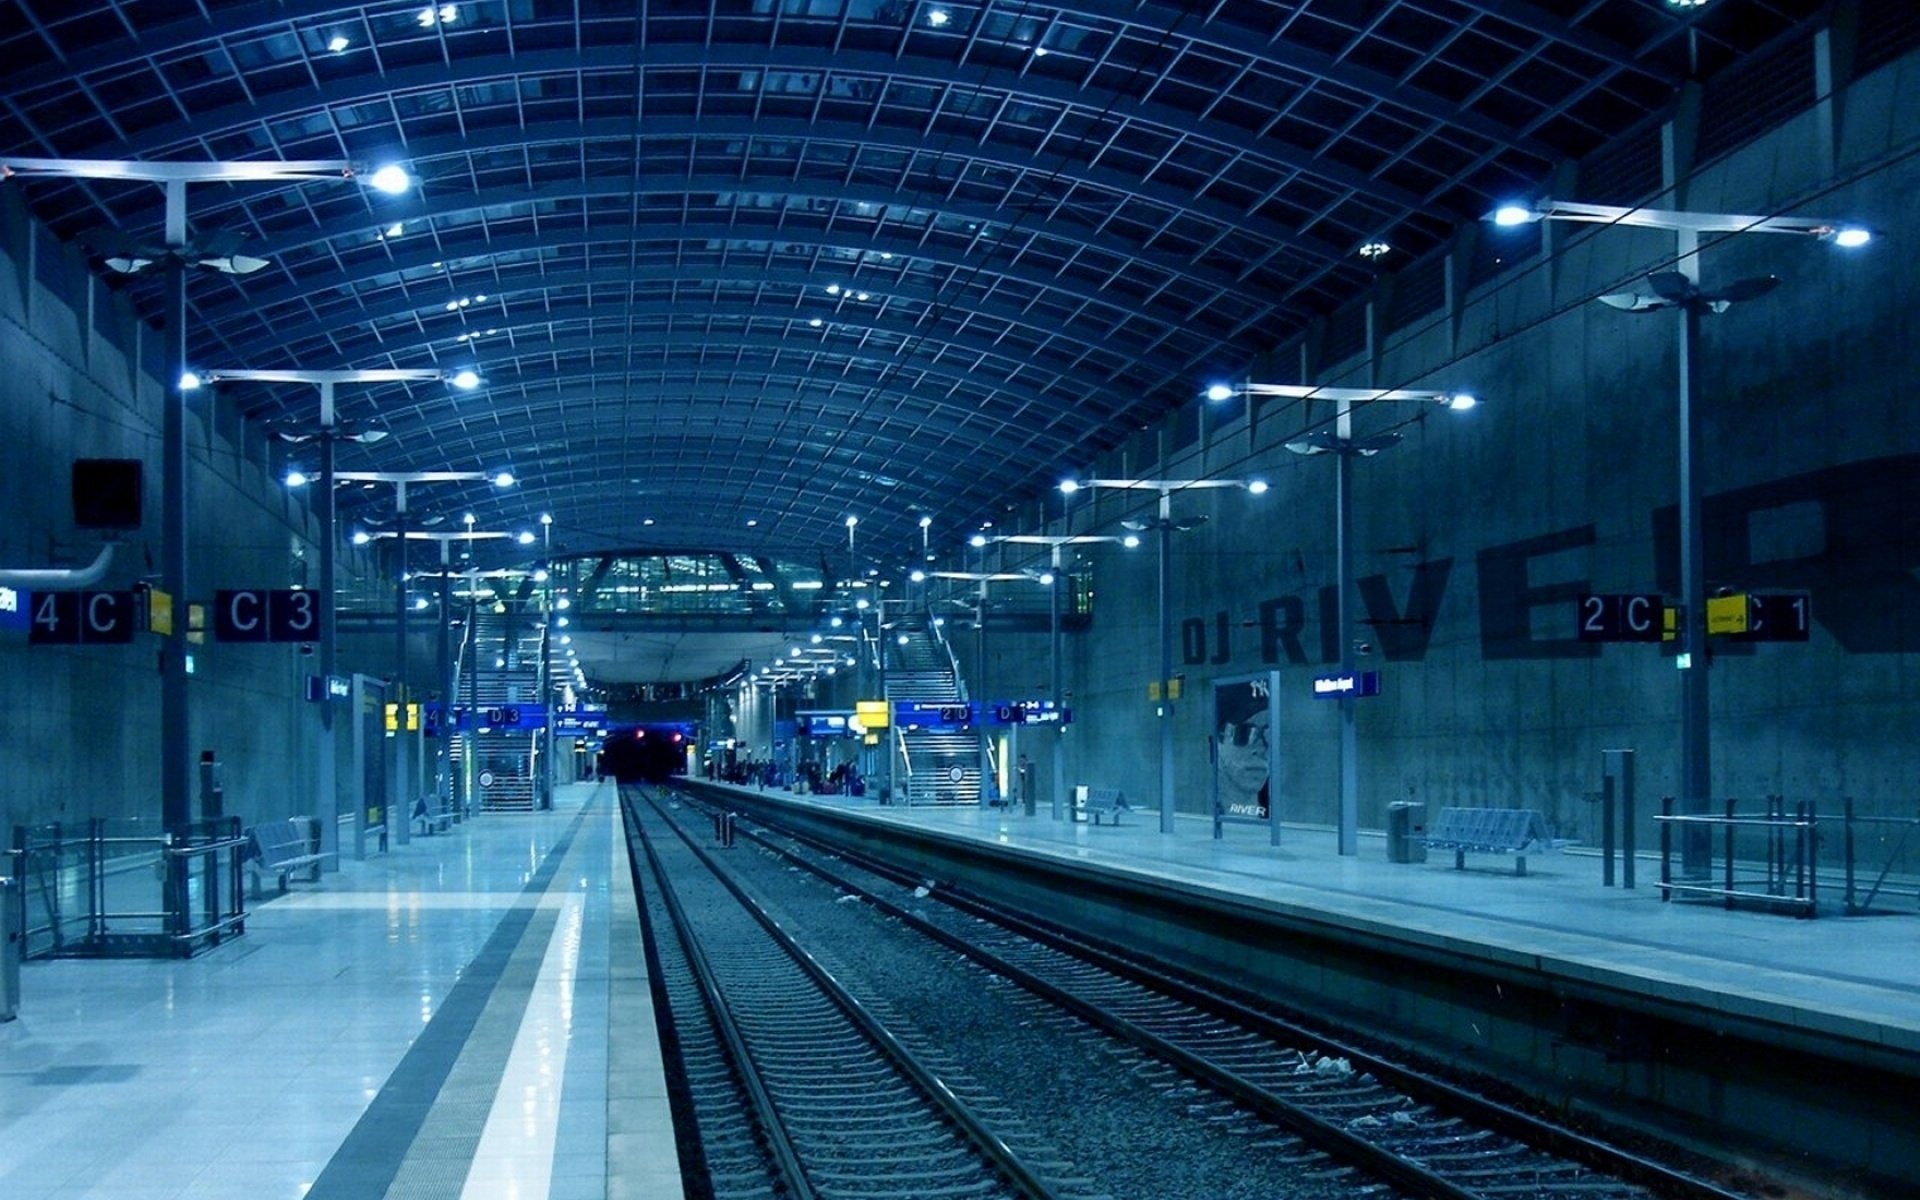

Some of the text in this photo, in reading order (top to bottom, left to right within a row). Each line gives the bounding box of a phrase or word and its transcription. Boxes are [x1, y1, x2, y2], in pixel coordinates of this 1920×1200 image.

[1182, 454, 1920, 665] DJ RIVER
[35, 594, 59, 631] 4
[89, 593, 116, 631] C
[231, 592, 312, 630] C 3
[1584, 597, 1651, 631] 2 C
[1792, 598, 1805, 631] 1
[492, 708, 519, 722] D 3
[943, 707, 951, 720] 2
[1001, 707, 1010, 719] D
[1230, 803, 1266, 817] RIVER
